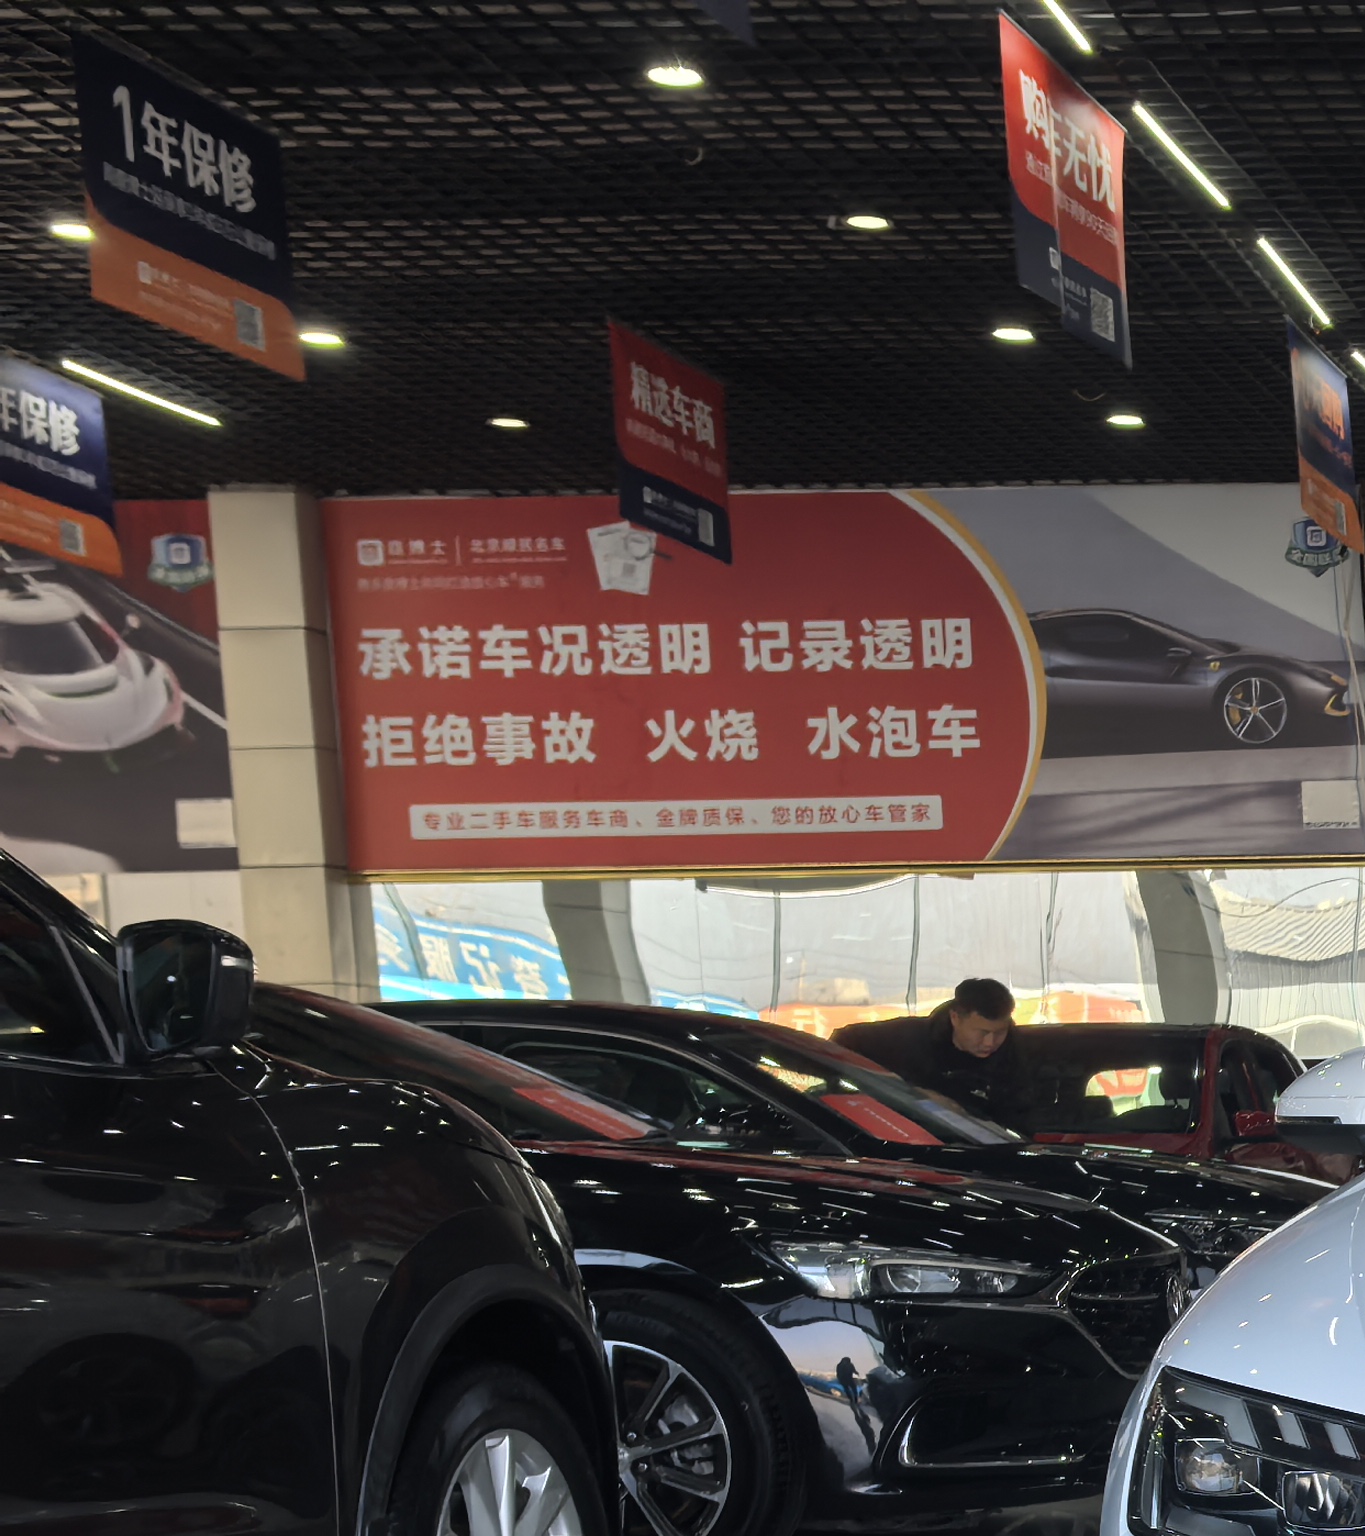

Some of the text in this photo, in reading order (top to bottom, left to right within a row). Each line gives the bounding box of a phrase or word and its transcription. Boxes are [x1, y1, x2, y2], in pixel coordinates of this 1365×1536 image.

[112, 85, 256, 213] 1年保修
[357, 618, 973, 680] 承诺车况透明 记录透明
[361, 705, 981, 767] 拒绝事故 火烧 水泡车
